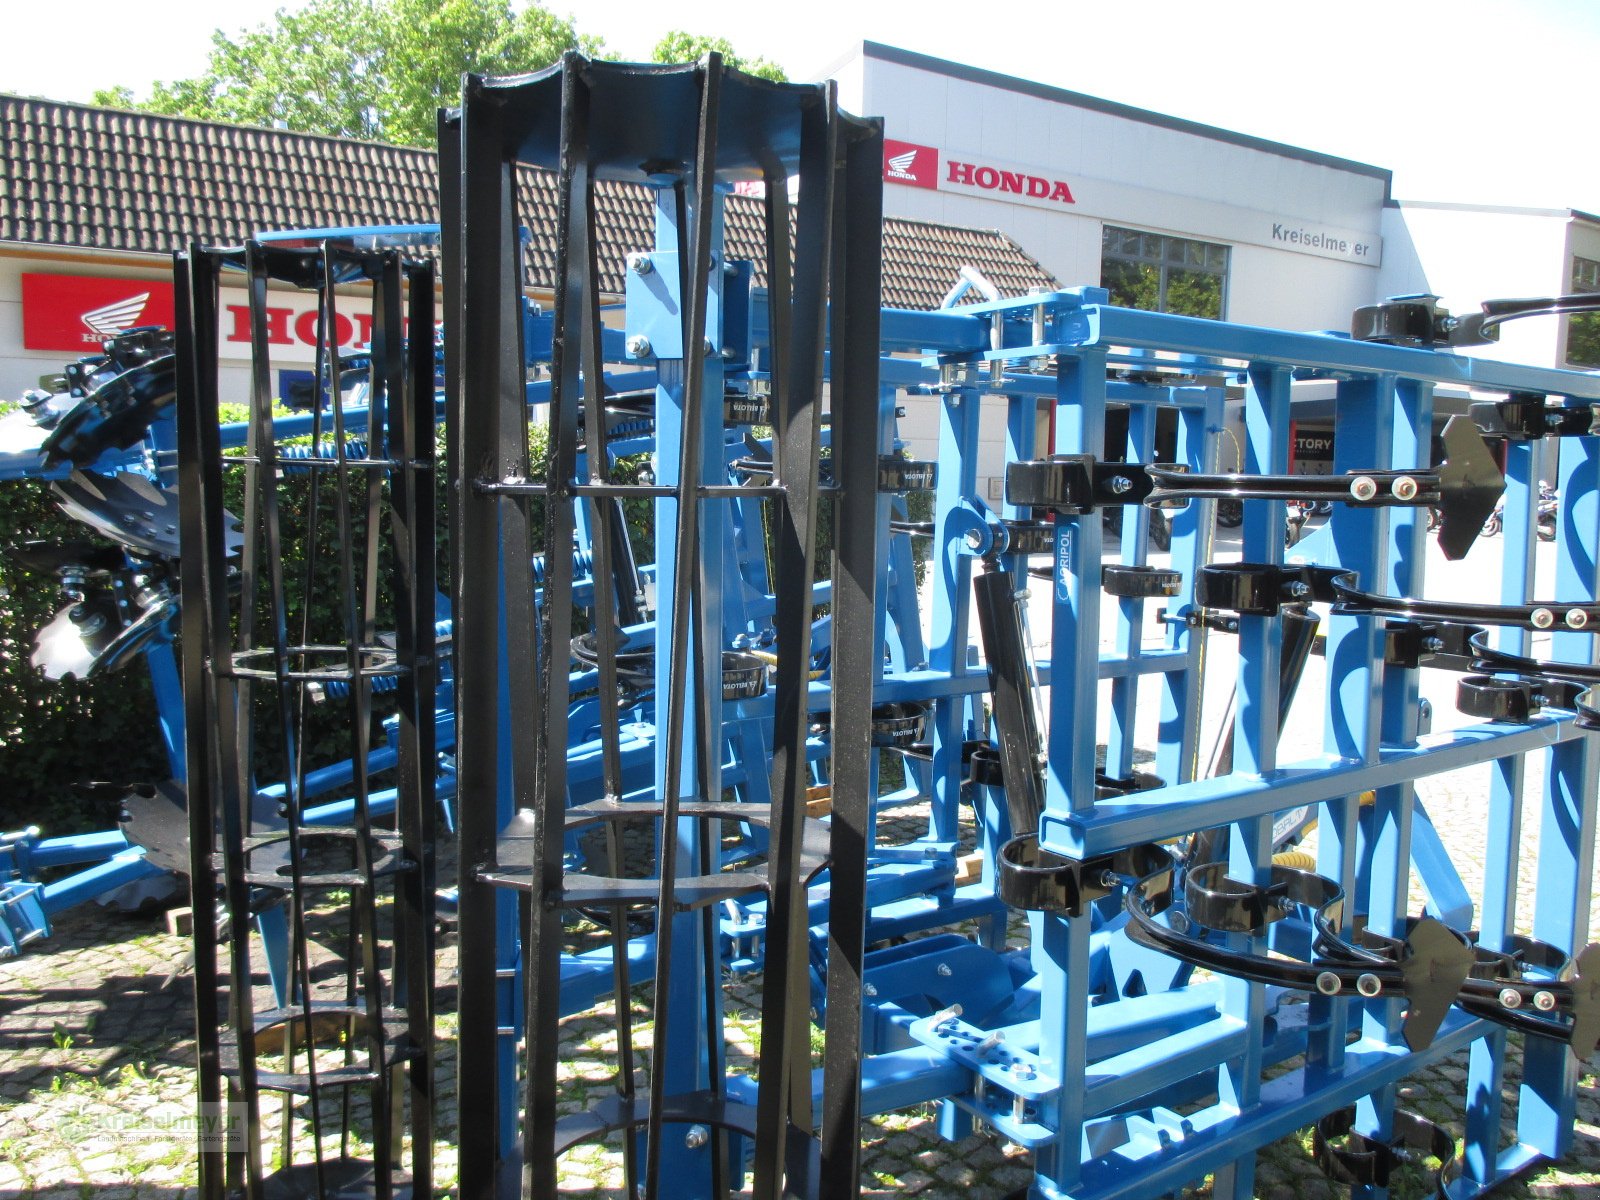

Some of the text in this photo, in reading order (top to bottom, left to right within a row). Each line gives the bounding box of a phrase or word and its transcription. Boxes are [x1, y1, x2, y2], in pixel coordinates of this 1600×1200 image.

[887, 170, 917, 181] HONDA
[946, 160, 1076, 203] HONDA
[1272, 223, 1369, 257] Kreiselmeer
[1294, 438, 1332, 449] TORY
